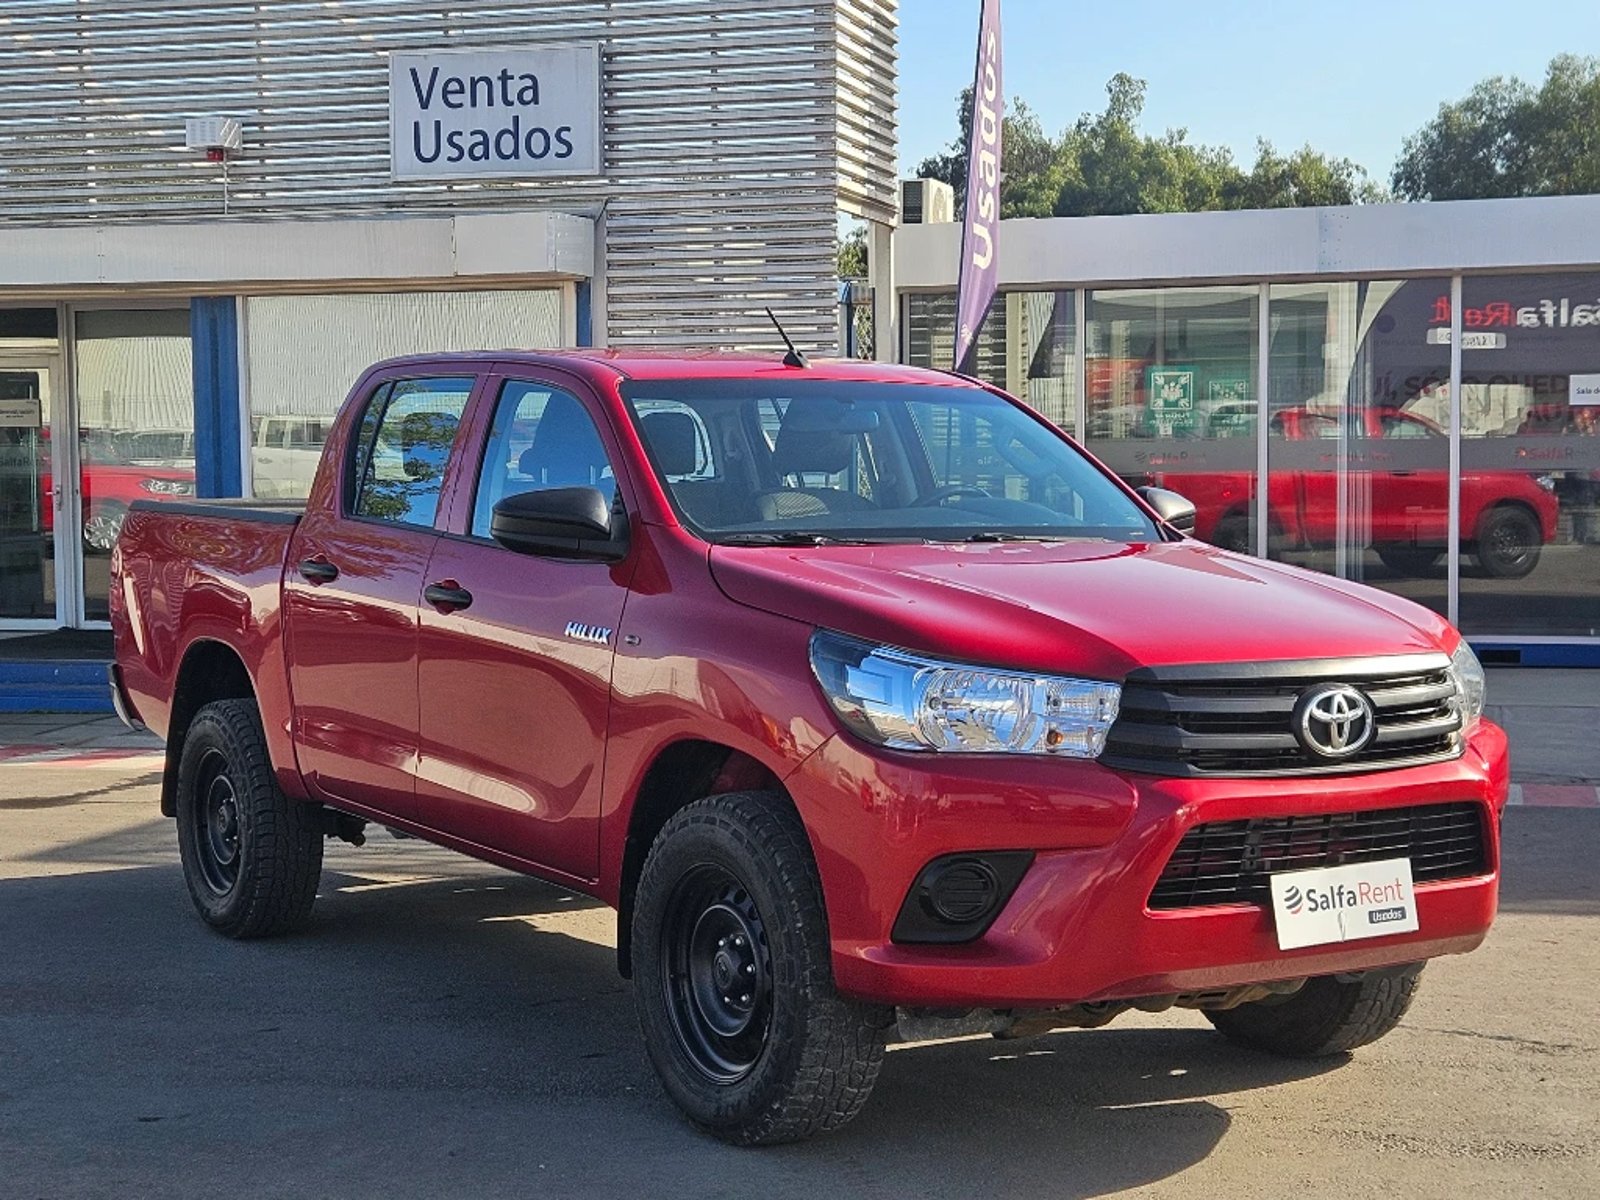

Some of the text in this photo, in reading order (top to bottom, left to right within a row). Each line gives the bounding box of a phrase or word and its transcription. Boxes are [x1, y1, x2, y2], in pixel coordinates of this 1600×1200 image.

[409, 66, 540, 110] Venta
[413, 115, 574, 163] Usados
[972, 28, 997, 270] Usados
[563, 621, 613, 645] HILUX
[1306, 877, 1405, 912] SalfaRent
[1372, 908, 1403, 922] Usados
